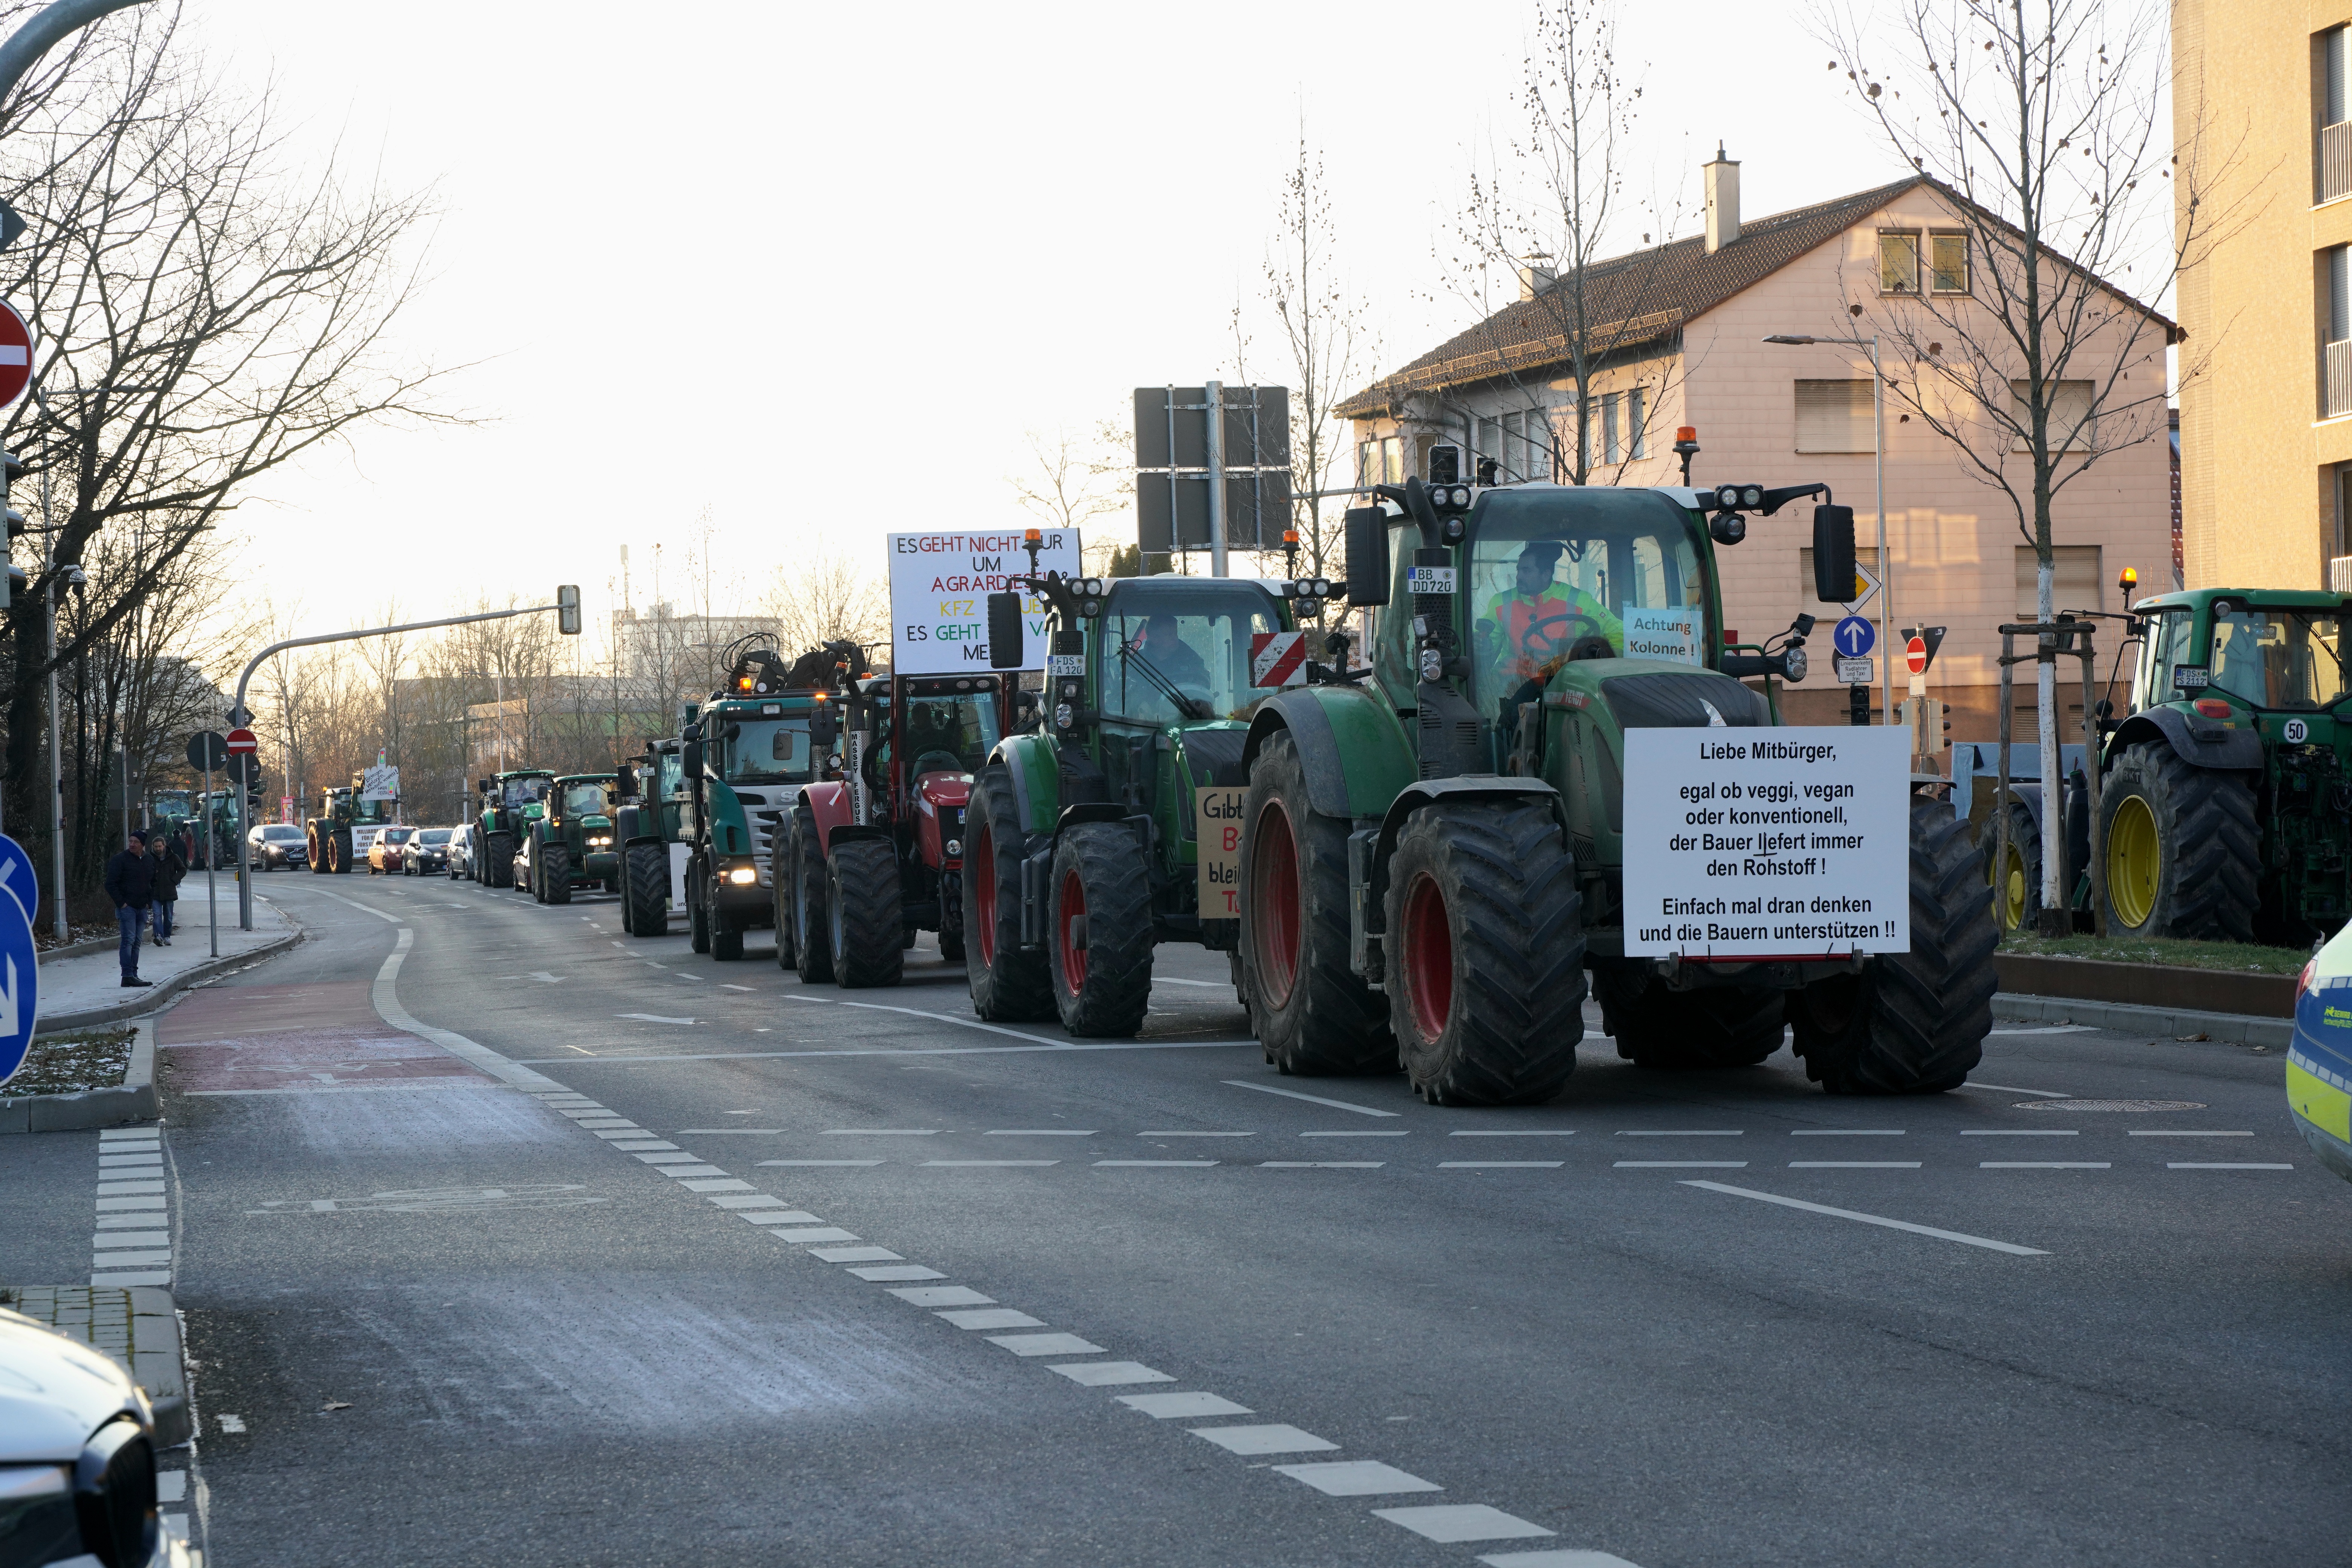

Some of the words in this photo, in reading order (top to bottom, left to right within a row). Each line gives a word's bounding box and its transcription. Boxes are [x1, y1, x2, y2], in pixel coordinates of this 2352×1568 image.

[897, 538, 918, 553] ES
[919, 536, 964, 552] GEHT
[970, 536, 1020, 552] NICHT
[1041, 534, 1063, 550] UR
[973, 557, 1000, 571] UM
[1418, 570, 1433, 580] BB
[941, 600, 975, 617] KFZ
[907, 626, 928, 641] ES
[936, 624, 981, 640] GEHT
[1634, 618, 1691, 635] Achtung
[1631, 641, 1686, 655] Kolonne
[1691, 644, 1694, 656] !
[1066, 666, 1082, 674] 120
[1565, 689, 1585, 706] FENDT
[2288, 723, 2303, 740] 50
[1701, 743, 1746, 760] Liebe
[1752, 742, 1836, 763] Mitbürger,
[2123, 770, 2141, 782] BKT
[1680, 782, 1715, 804] egal
[1721, 782, 1742, 799] ob
[1748, 781, 1798, 803] veggi,
[1804, 785, 1853, 802] vegan
[1686, 808, 1724, 825] oder
[1730, 807, 1847, 826] konventionell,
[1223, 827, 1241, 851] B
[1670, 834, 1698, 851] der
[1703, 833, 1752, 850] Bauer
[1758, 832, 1805, 851] liefert
[1811, 832, 1864, 849] immer
[1209, 862, 1240, 884] blei
[1707, 859, 1737, 876] den
[1744, 858, 1816, 876] Rohstoff
[1822, 858, 1825, 874] !
[1663, 897, 1726, 915] Einfach
[1732, 897, 1761, 914] mal
[1768, 897, 1804, 914] dran
[1811, 896, 1871, 913] denken
[1640, 925, 1671, 942] und
[1677, 924, 1702, 941] die
[1708, 923, 1767, 940] Bauern
[1774, 922, 1879, 939] unterstützen
[1886, 920, 1895, 937] !!
